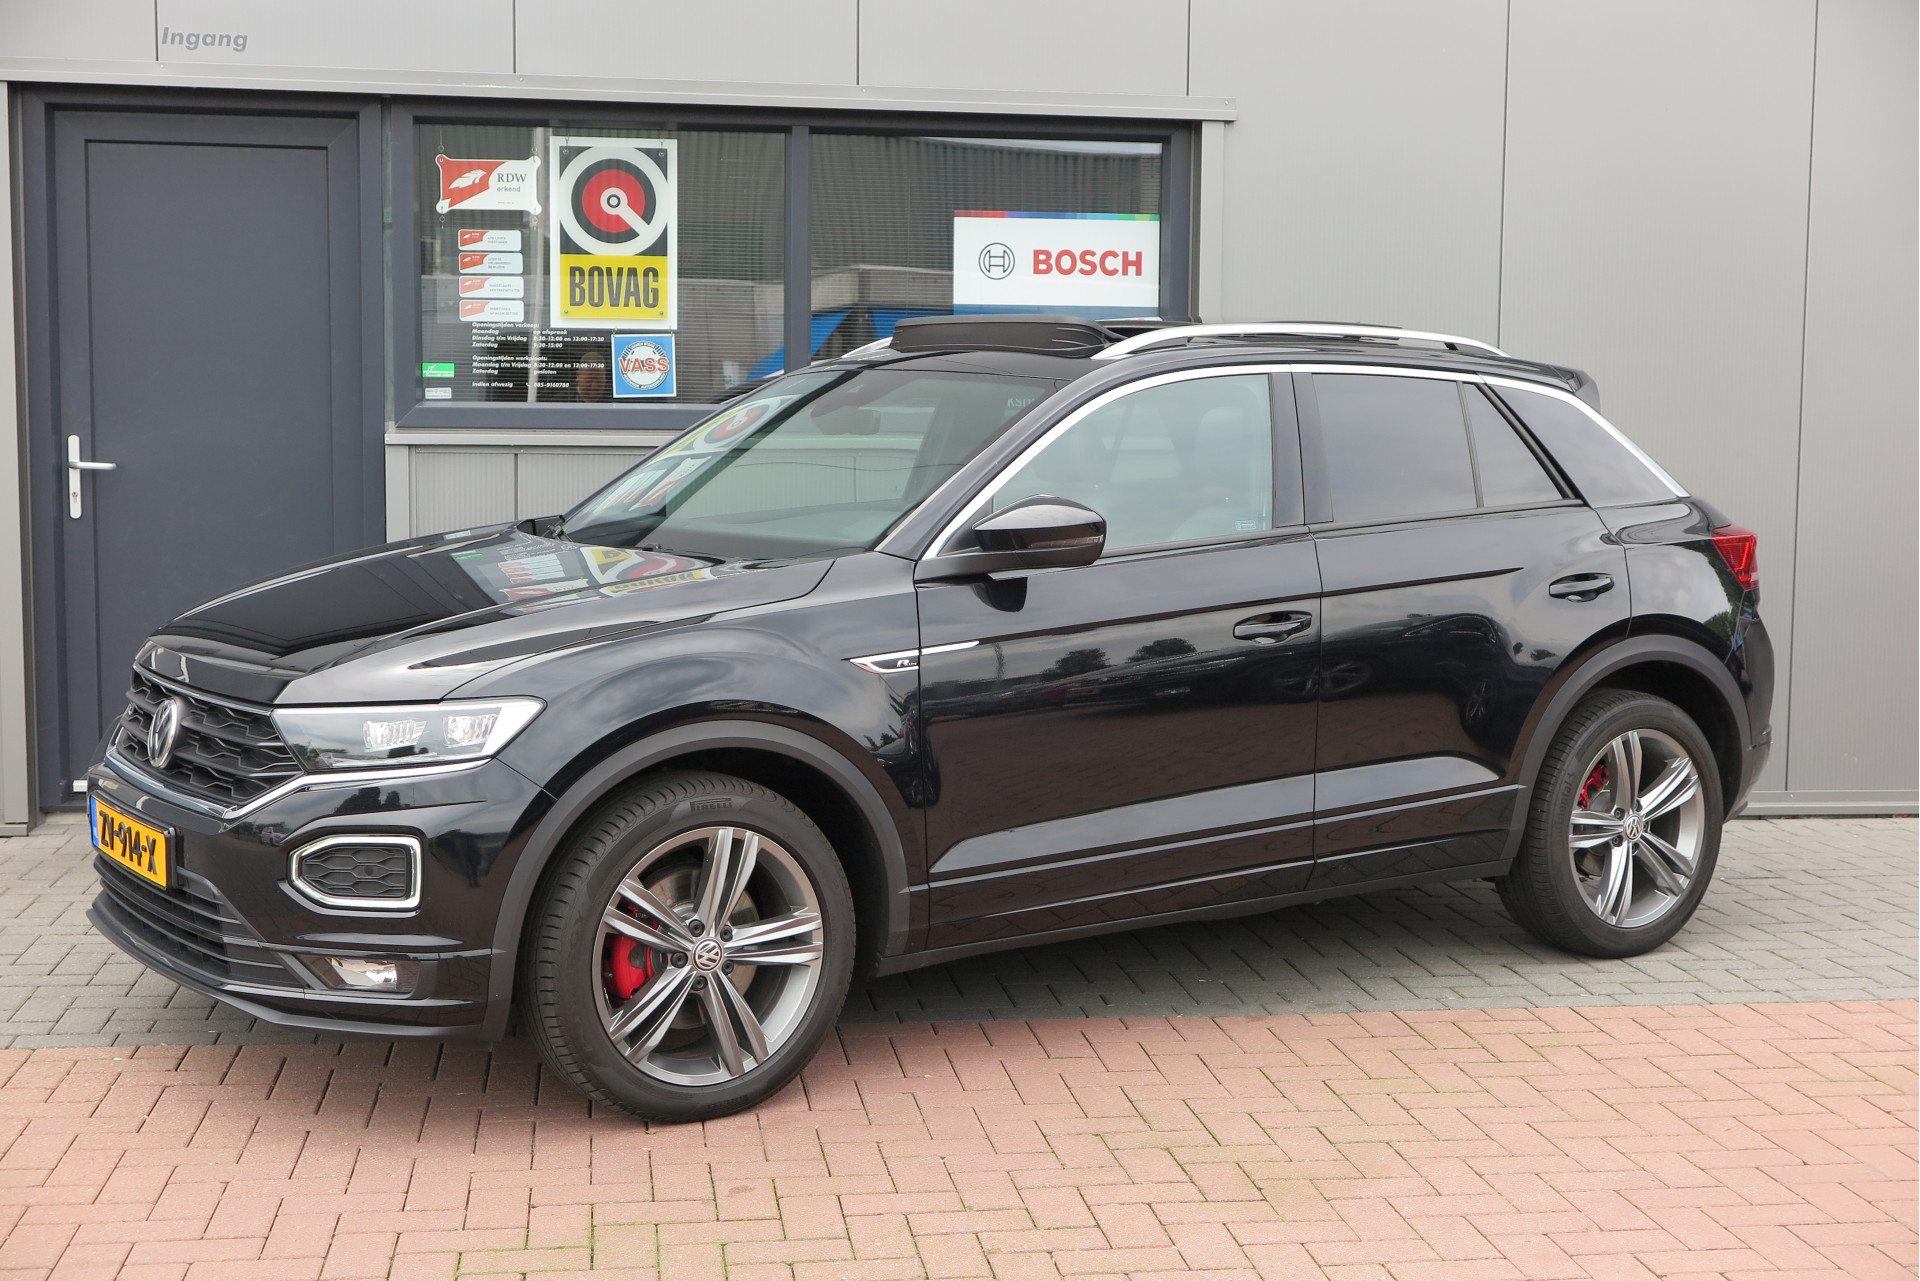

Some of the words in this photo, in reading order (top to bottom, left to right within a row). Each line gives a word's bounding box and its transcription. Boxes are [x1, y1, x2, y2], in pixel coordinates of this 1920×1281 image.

[162, 27, 248, 52] Ingang
[497, 173, 527, 183] RDW
[1033, 249, 1142, 276] BOSCH
[569, 266, 659, 308] BOVAG
[619, 357, 669, 373] VASS
[690, 797, 732, 811] PIRELLI
